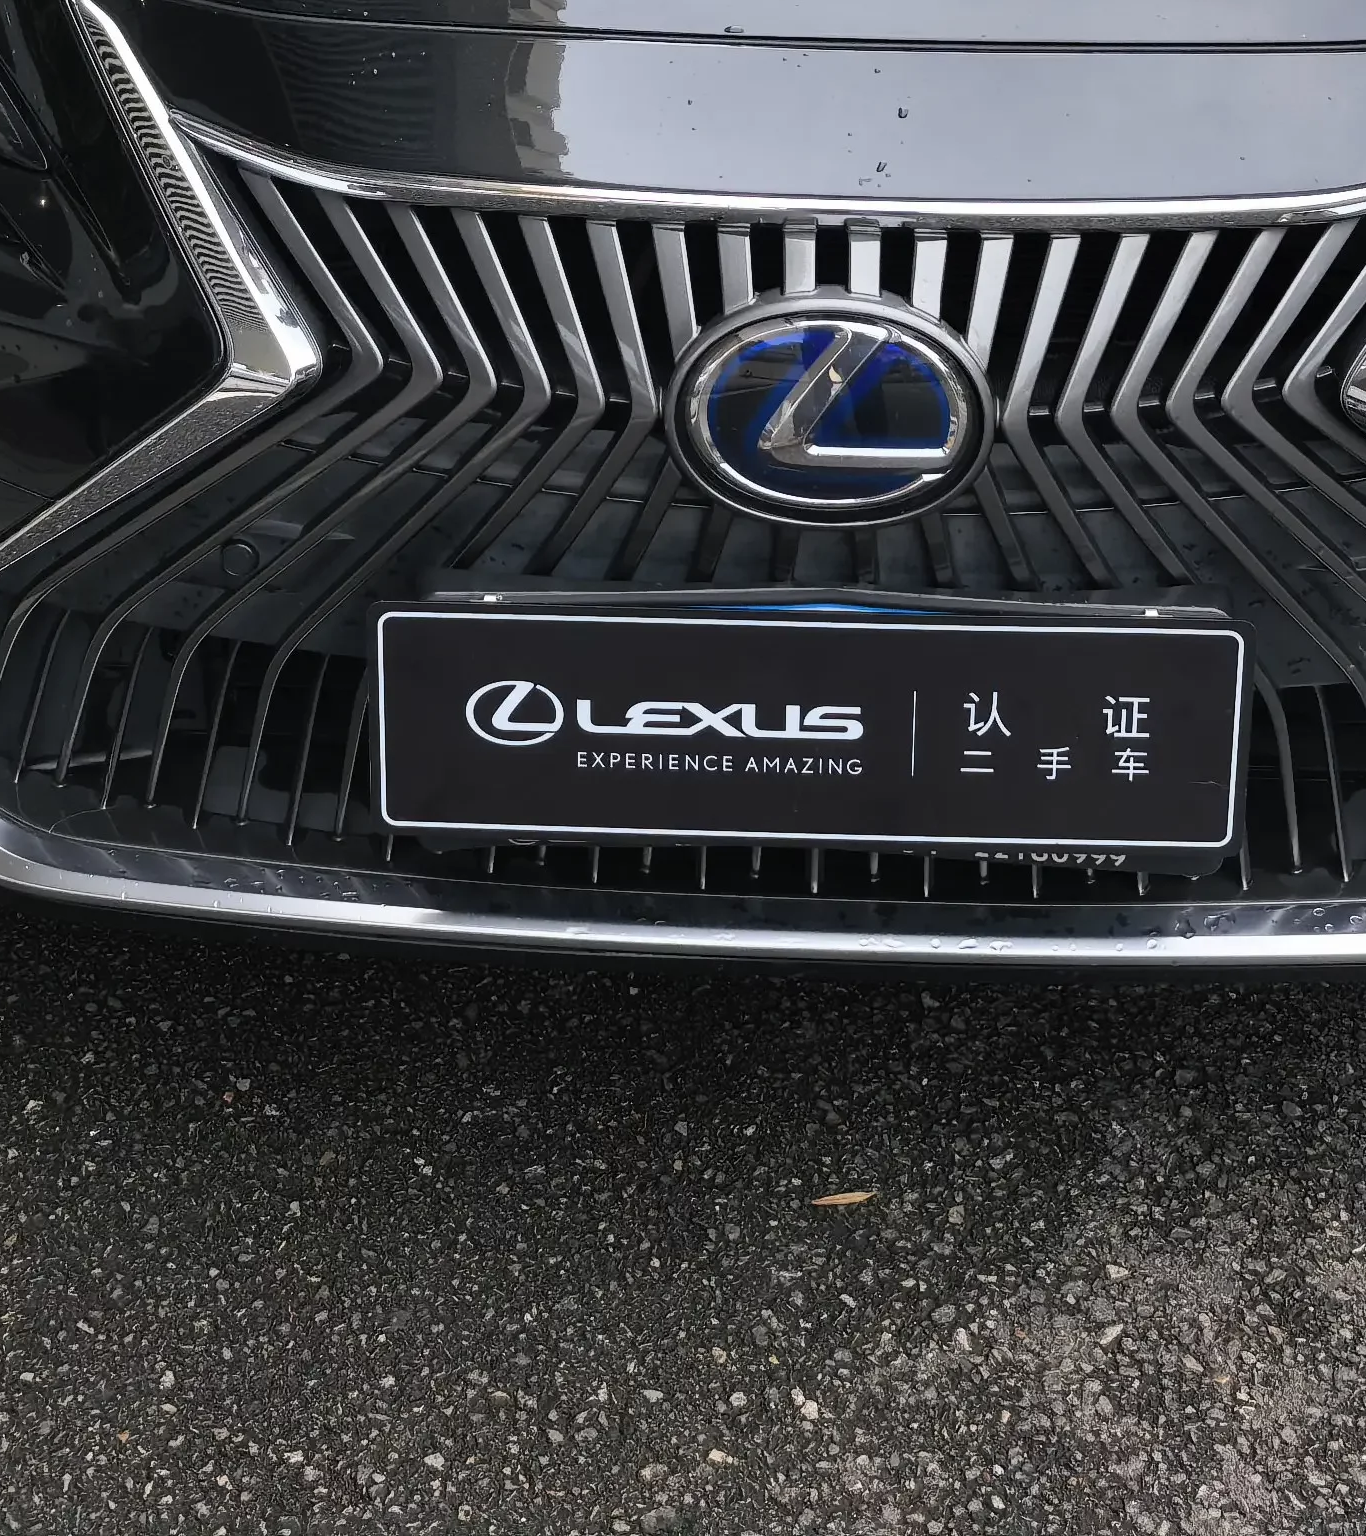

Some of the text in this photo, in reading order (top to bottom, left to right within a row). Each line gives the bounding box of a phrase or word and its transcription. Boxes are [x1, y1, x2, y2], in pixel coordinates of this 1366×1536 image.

[576, 698, 865, 741] LEXUS
[962, 690, 1151, 738] 认证
[577, 751, 864, 776] EXPERIENCE AMAZING
[959, 746, 1150, 783] 二手车
